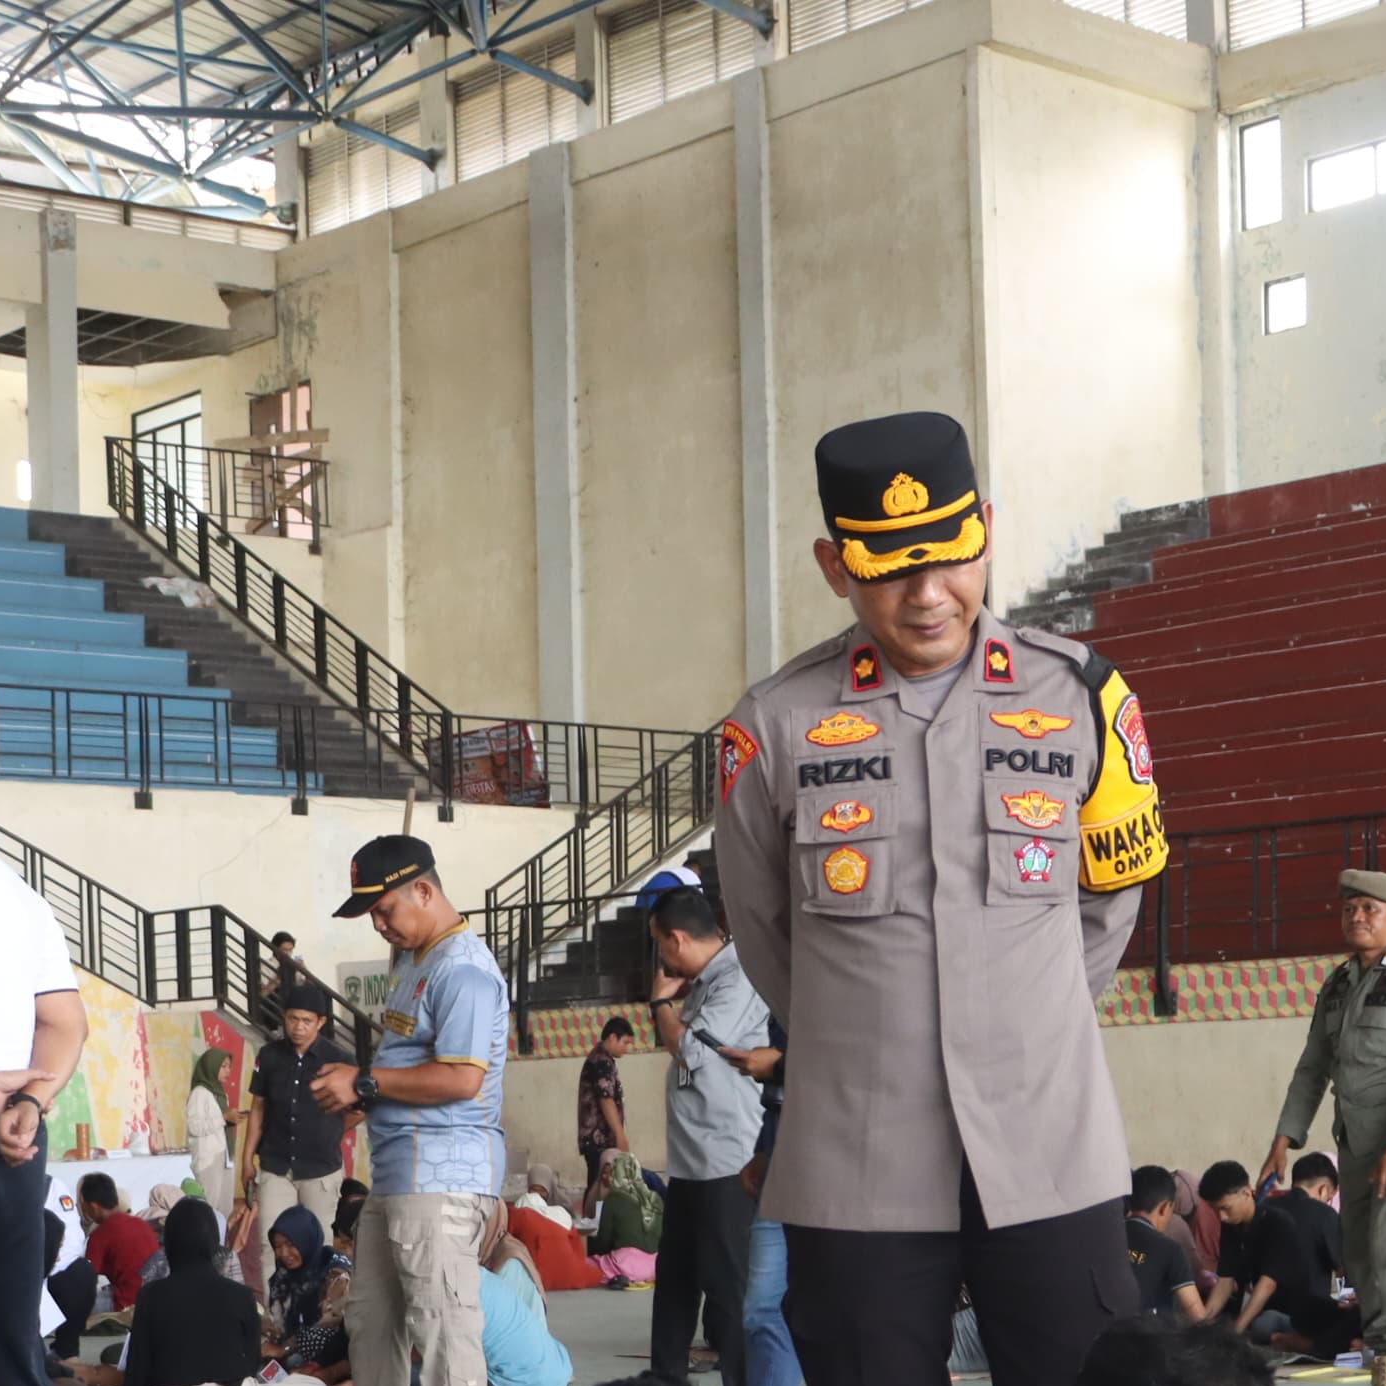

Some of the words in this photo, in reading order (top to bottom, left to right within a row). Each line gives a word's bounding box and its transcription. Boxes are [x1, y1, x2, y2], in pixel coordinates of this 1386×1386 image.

[799, 755, 892, 788] RIZKI
[985, 748, 1075, 778] POLRI
[1087, 812, 1155, 862] WAKA
[1114, 845, 1153, 875] OMP
